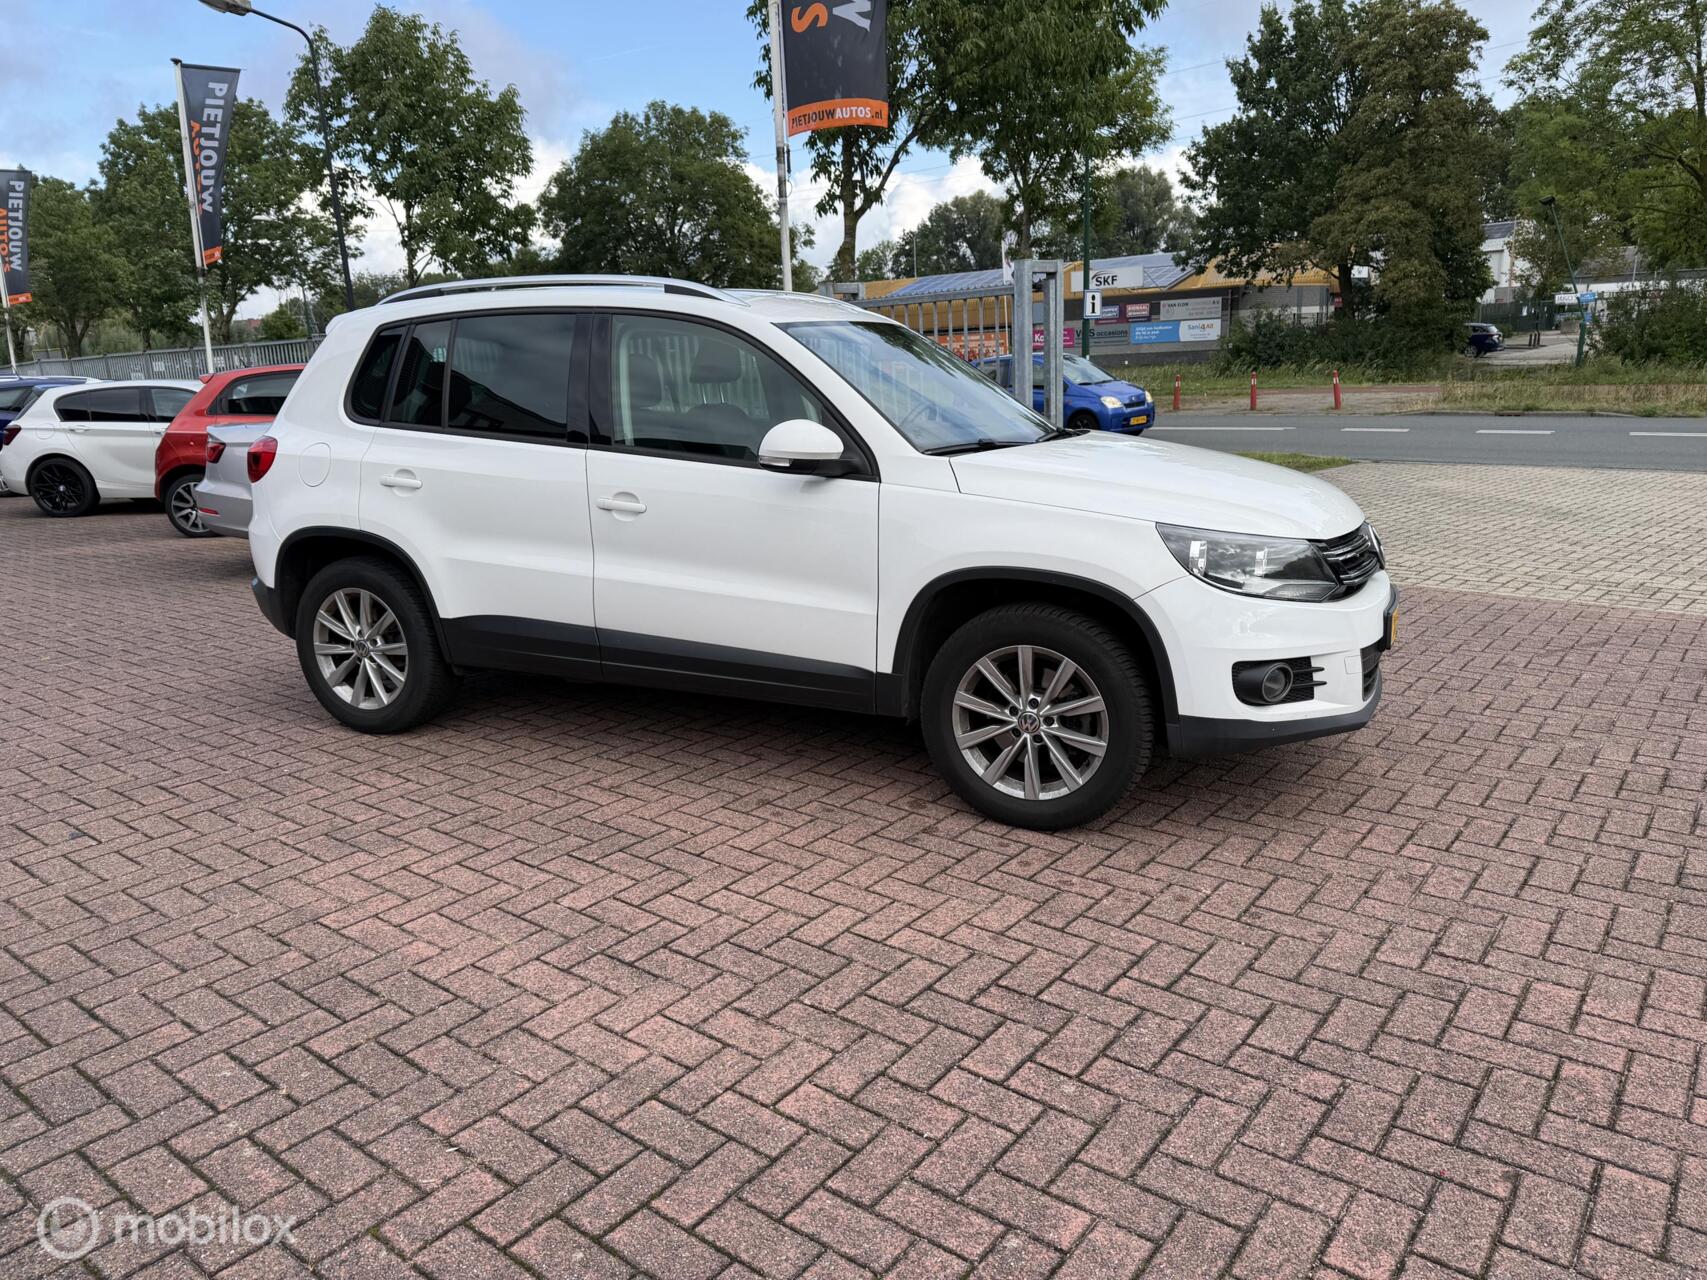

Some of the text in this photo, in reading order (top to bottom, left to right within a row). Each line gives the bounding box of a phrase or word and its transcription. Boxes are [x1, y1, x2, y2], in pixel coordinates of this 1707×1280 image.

[791, 106, 883, 129] PIETJOUWAUTOS.nl
[200, 81, 229, 213] PIETJOUW
[8, 180, 25, 271] PIETJOUW
[1095, 275, 1118, 287] SKF
[1096, 329, 1128, 337] occasions
